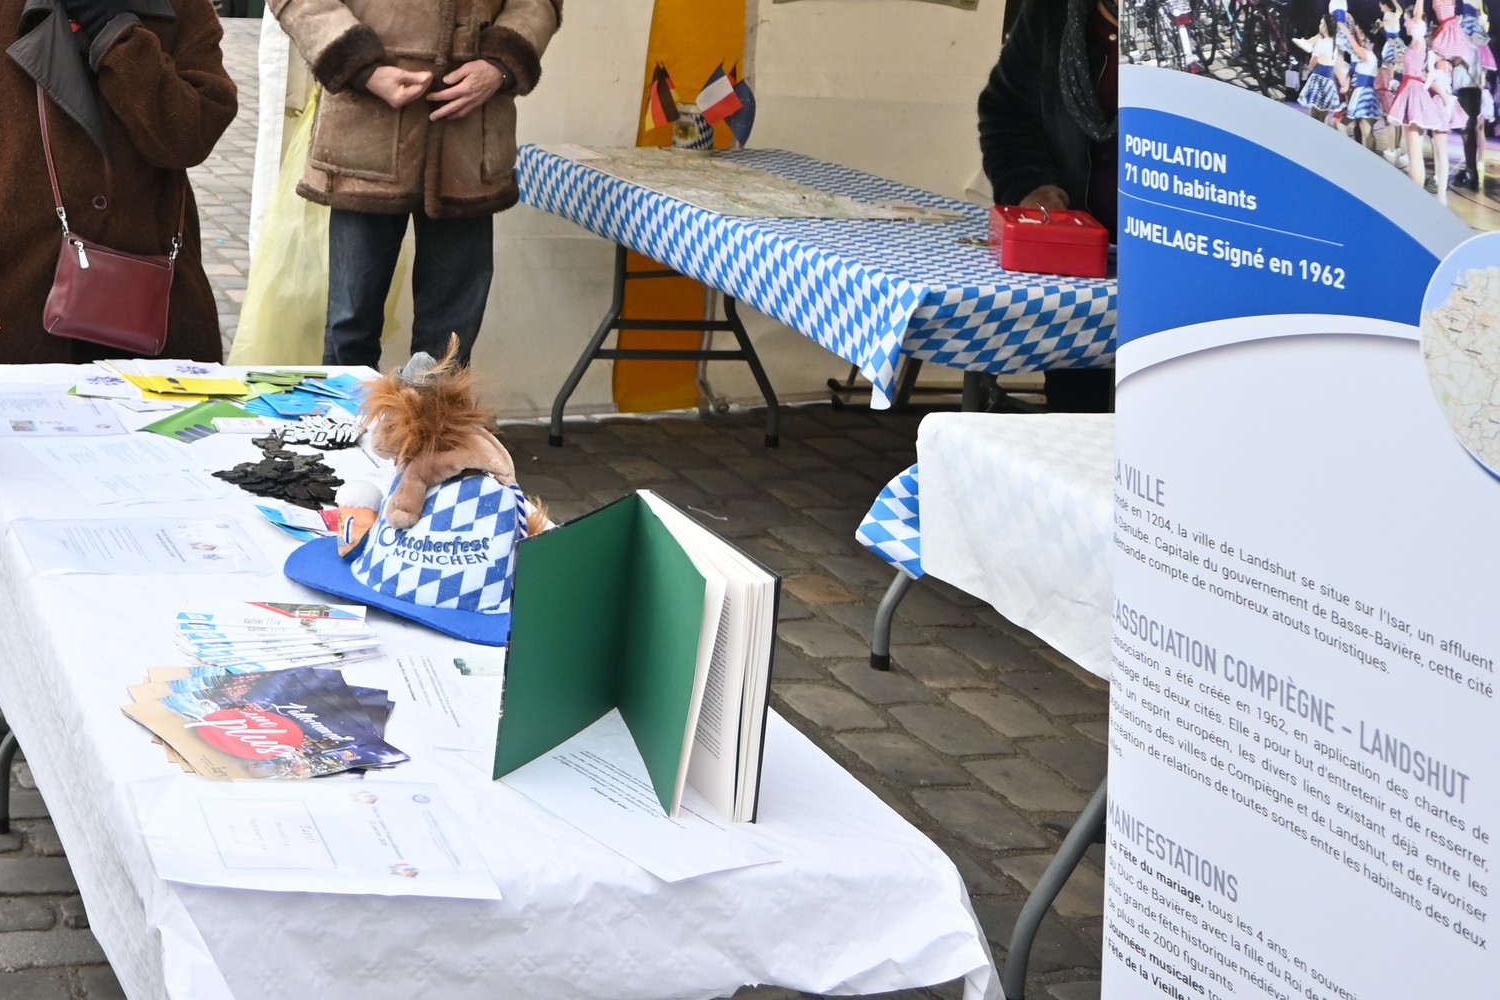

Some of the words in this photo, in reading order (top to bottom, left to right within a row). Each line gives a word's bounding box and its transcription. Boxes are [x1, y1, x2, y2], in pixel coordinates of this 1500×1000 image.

[1124, 133, 1228, 175] POPULATION
[1124, 162, 1138, 183] 71
[1141, 166, 1169, 192] 000
[1172, 174, 1258, 211] habitants
[1124, 215, 1209, 256] JUMELAGE
[1212, 238, 1265, 270] Signé
[1268, 254, 1293, 276] en
[1298, 258, 1346, 291] 1962
[378, 525, 490, 554] Oktoberfest
[1125, 463, 1165, 507] VILLE
[391, 547, 490, 566] MÜNCHEN
[1118, 515, 1152, 545] Danube.
[1154, 535, 1200, 566] Capitale
[1202, 556, 1218, 573] du
[1221, 566, 1309, 612] gouvernement
[1312, 602, 1328, 620] de
[1330, 609, 1425, 668] Basse-Bavière,
[1428, 658, 1464, 685] cette
[1467, 677, 1494, 698] cité
[1145, 509, 1174, 534] 1204,
[1177, 522, 1188, 539] la
[1192, 530, 1216, 550] ville
[1219, 541, 1235, 557] de
[1239, 547, 1297, 583] Landshut
[1301, 575, 1316, 590] se
[1320, 583, 1350, 606] situe
[1354, 599, 1375, 617] sur
[1417, 628, 1434, 646] un
[1439, 638, 1494, 673] affluent
[1148, 555, 1190, 582] compte
[1192, 574, 1206, 590] de
[1209, 583, 1270, 617] nombreux
[1271, 609, 1311, 636] atouts
[1314, 626, 1391, 675] touristiques.
[1142, 675, 1161, 694] des
[1163, 686, 1191, 709] deux
[1194, 702, 1226, 726] cités.
[1228, 716, 1250, 737] Elle
[1263, 737, 1292, 759] pour
[1294, 749, 1314, 772] but
[1317, 763, 1387, 812] d'entretenir
[1389, 806, 1402, 823] et
[1405, 814, 1422, 834] de
[1425, 826, 1489, 873] resserrer,
[1176, 669, 1195, 688] été
[1198, 682, 1232, 705] créée
[1236, 699, 1251, 715] en
[1256, 706, 1288, 735] 1962,
[1293, 728, 1308, 744] en
[1313, 739, 1381, 784] application
[1386, 778, 1409, 800] des
[1414, 794, 1466, 832] chartes
[1472, 826, 1490, 844] de
[1223, 653, 1336, 734] COMPIÈGNE
[1360, 719, 1471, 805] LANDSHUT
[1108, 794, 1239, 903] MANIFESTATIONS
[1141, 697, 1171, 722] esprit
[1176, 716, 1233, 754] européen,
[1238, 743, 1256, 764] les
[1261, 757, 1298, 787] divers
[1302, 778, 1331, 806] liens
[1336, 800, 1387, 839] existant
[1391, 832, 1419, 858] déjà
[1425, 852, 1461, 882] entre
[1467, 873, 1488, 897] les
[1147, 743, 1161, 761] de
[1162, 754, 1212, 787] relations
[1214, 779, 1229, 796] de
[1231, 788, 1269, 818] toutes
[1271, 811, 1308, 841] sortes
[1310, 834, 1341, 861] entre
[1343, 849, 1361, 873] les
[1363, 862, 1423, 912] habitants
[1425, 904, 1450, 928] des
[1453, 920, 1488, 951] deux
[1155, 725, 1175, 745] des
[1178, 738, 1208, 763] villes
[1210, 754, 1225, 772] de
[1227, 762, 1294, 809] Compiègne
[1311, 809, 1326, 827] de
[1329, 818, 1389, 867] Landshut,
[1391, 858, 1405, 876] et
[1407, 866, 1423, 886] de
[1426, 876, 1488, 923] favoriser
[1108, 918, 1147, 959] Journées
[1149, 951, 1206, 996] musicales
[1116, 905, 1136, 929] plus
[1137, 920, 1151, 938] de
[1153, 931, 1181, 957] 2000
[1183, 949, 1236, 994] figurants.
[1117, 862, 1135, 886] Duc
[1136, 878, 1149, 895] de
[1151, 886, 1199, 926] Bavières
[1201, 920, 1229, 943] avec
[1230, 933, 1241, 952] la
[1243, 942, 1265, 967] fille
[1266, 959, 1282, 978] du
[1284, 969, 1303, 993] Roi
[1119, 842, 1138, 867] Fête
[1140, 859, 1154, 877] du
[1156, 868, 1205, 908] mariage,
[1207, 899, 1234, 924] tous
[1236, 914, 1254, 937] les
[1267, 937, 1291, 963] ans,
[1293, 956, 1308, 973] en
[1123, 891, 1157, 922] grande
[1158, 912, 1180, 935] fête
[1181, 924, 1239, 972] historique
[1125, 956, 1138, 973] de
